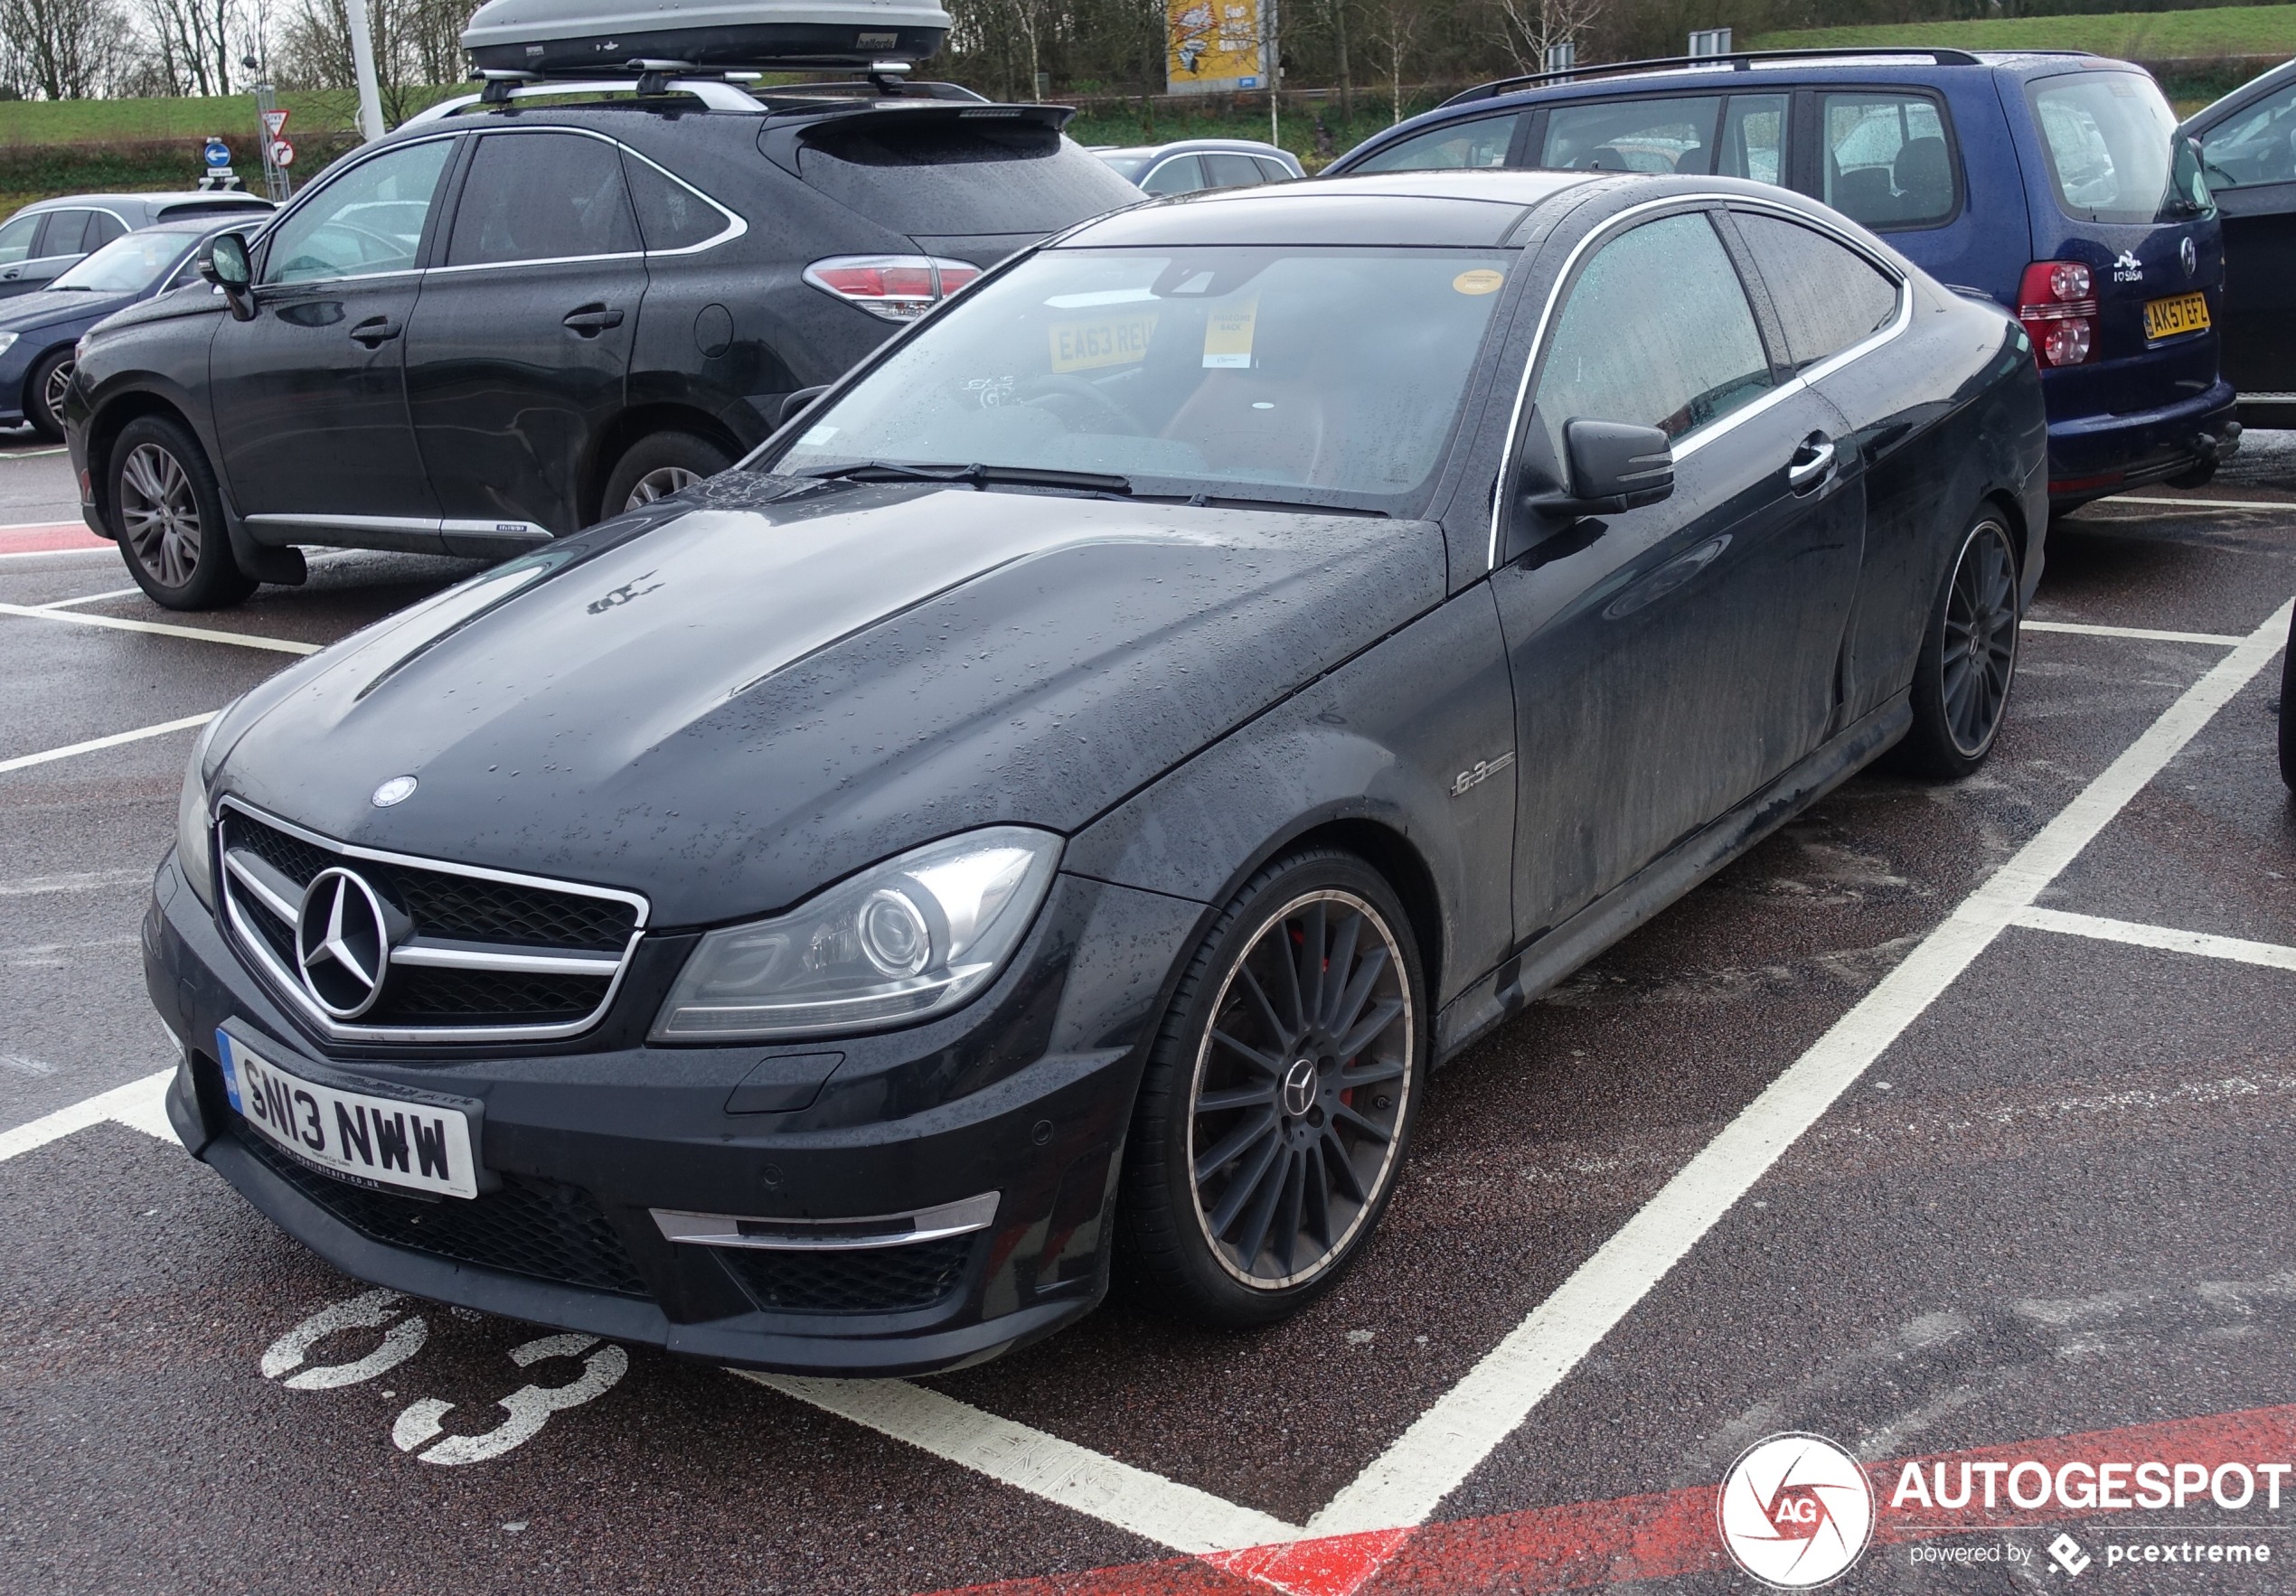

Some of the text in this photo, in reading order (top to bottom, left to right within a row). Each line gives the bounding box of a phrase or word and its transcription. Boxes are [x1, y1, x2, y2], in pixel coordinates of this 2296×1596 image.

[1213, 314, 1252, 322] WELCOME
[1220, 324, 1241, 332] BACK
[2151, 296, 2208, 333] AK57 EFZ
[1058, 325, 1114, 361] EA63
[1456, 760, 1487, 794] 6.3
[243, 1058, 450, 1181] SN13 NWW
